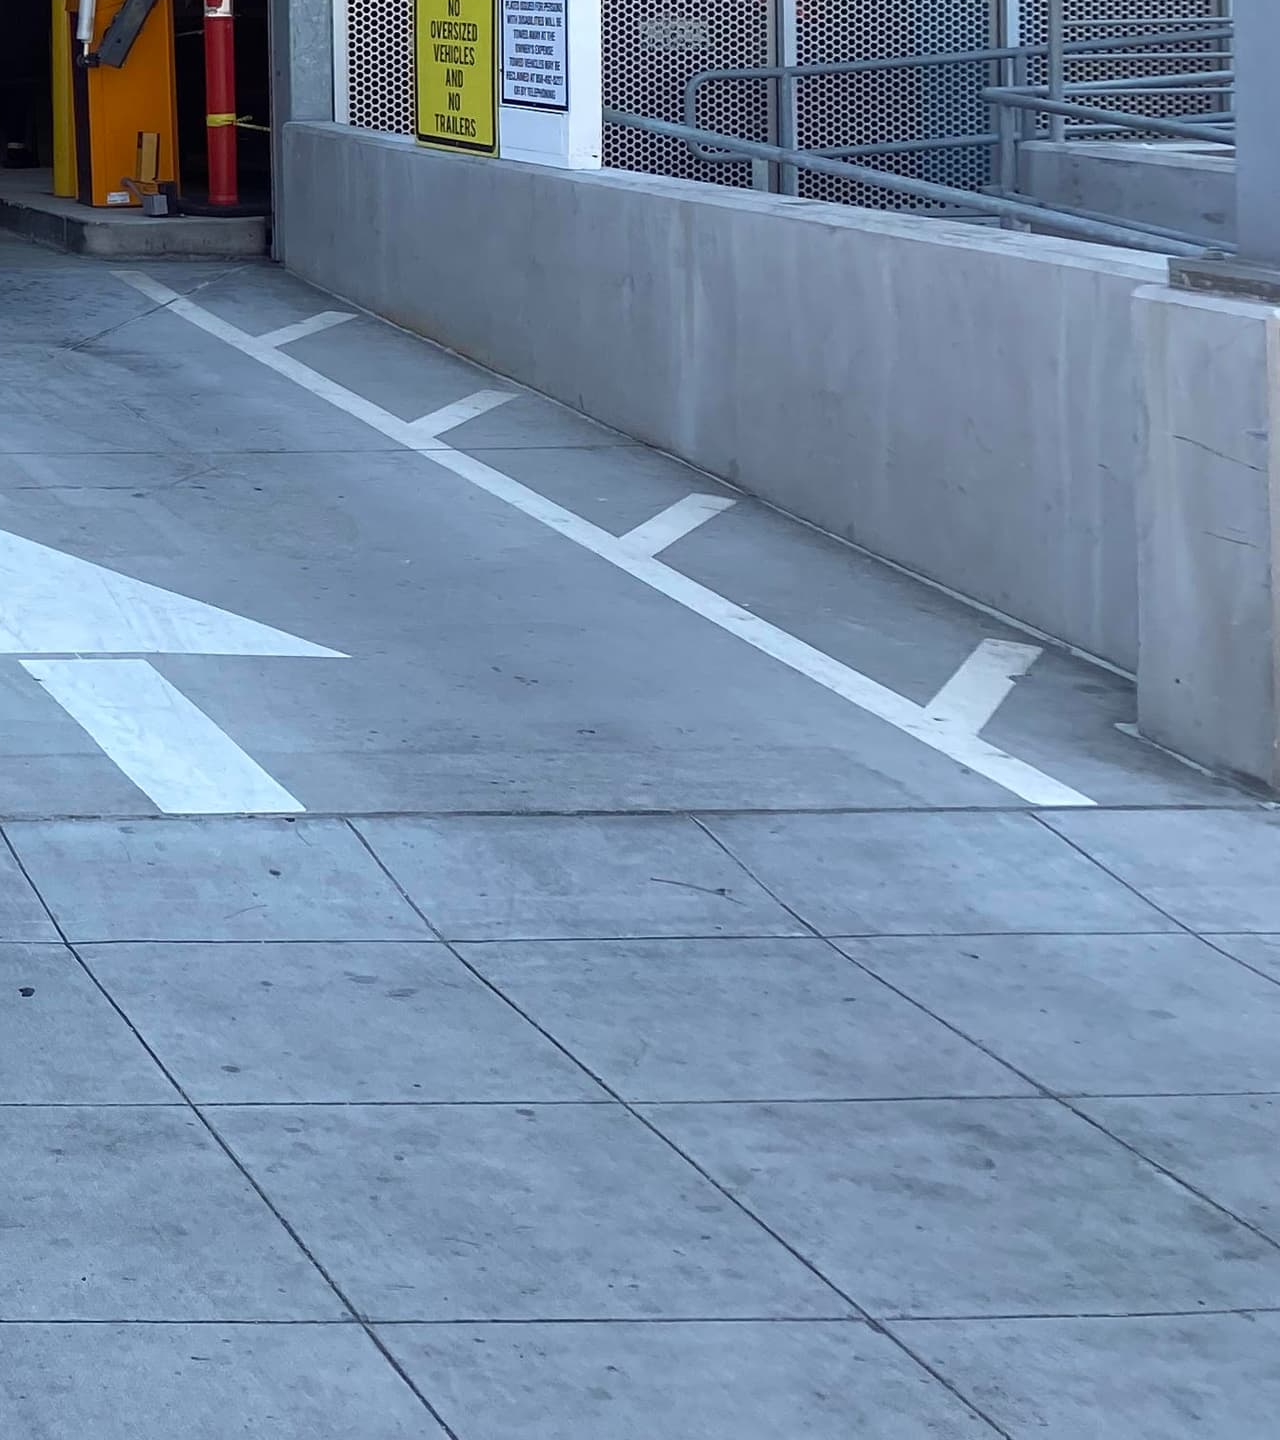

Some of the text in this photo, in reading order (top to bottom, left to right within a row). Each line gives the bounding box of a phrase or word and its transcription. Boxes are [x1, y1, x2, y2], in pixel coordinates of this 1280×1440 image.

[430, 20, 478, 42] OVERSIZED
[433, 44, 476, 66] VEHICLES
[445, 68, 464, 88] AND
[447, 92, 461, 112] NO
[434, 114, 477, 138] TRAILERS
